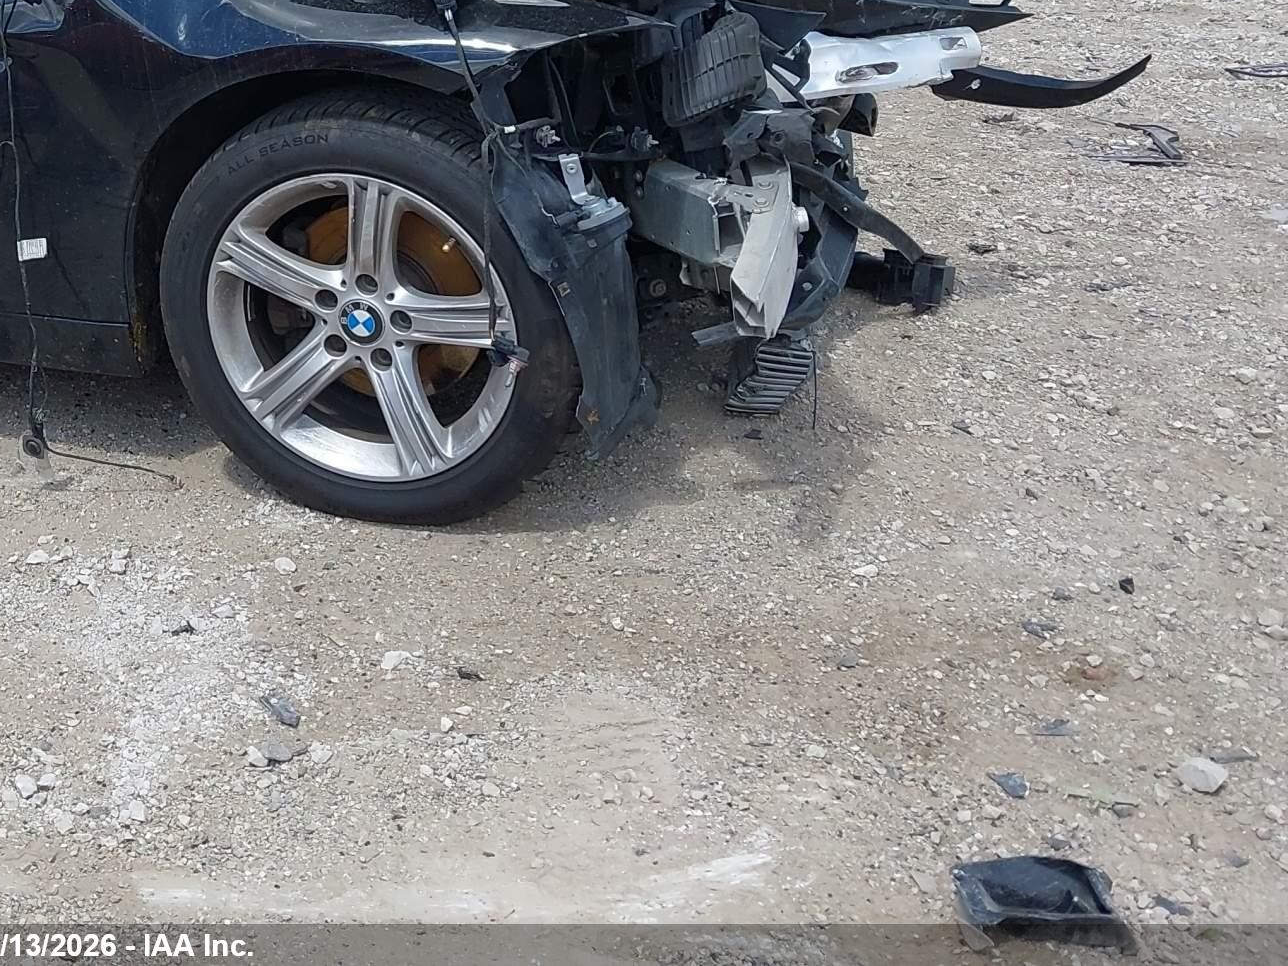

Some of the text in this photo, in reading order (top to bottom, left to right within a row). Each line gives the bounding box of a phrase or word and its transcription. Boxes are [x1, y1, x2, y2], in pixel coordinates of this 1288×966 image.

[227, 134, 329, 174] ALL SEASON
[340, 301, 369, 325] BMW
